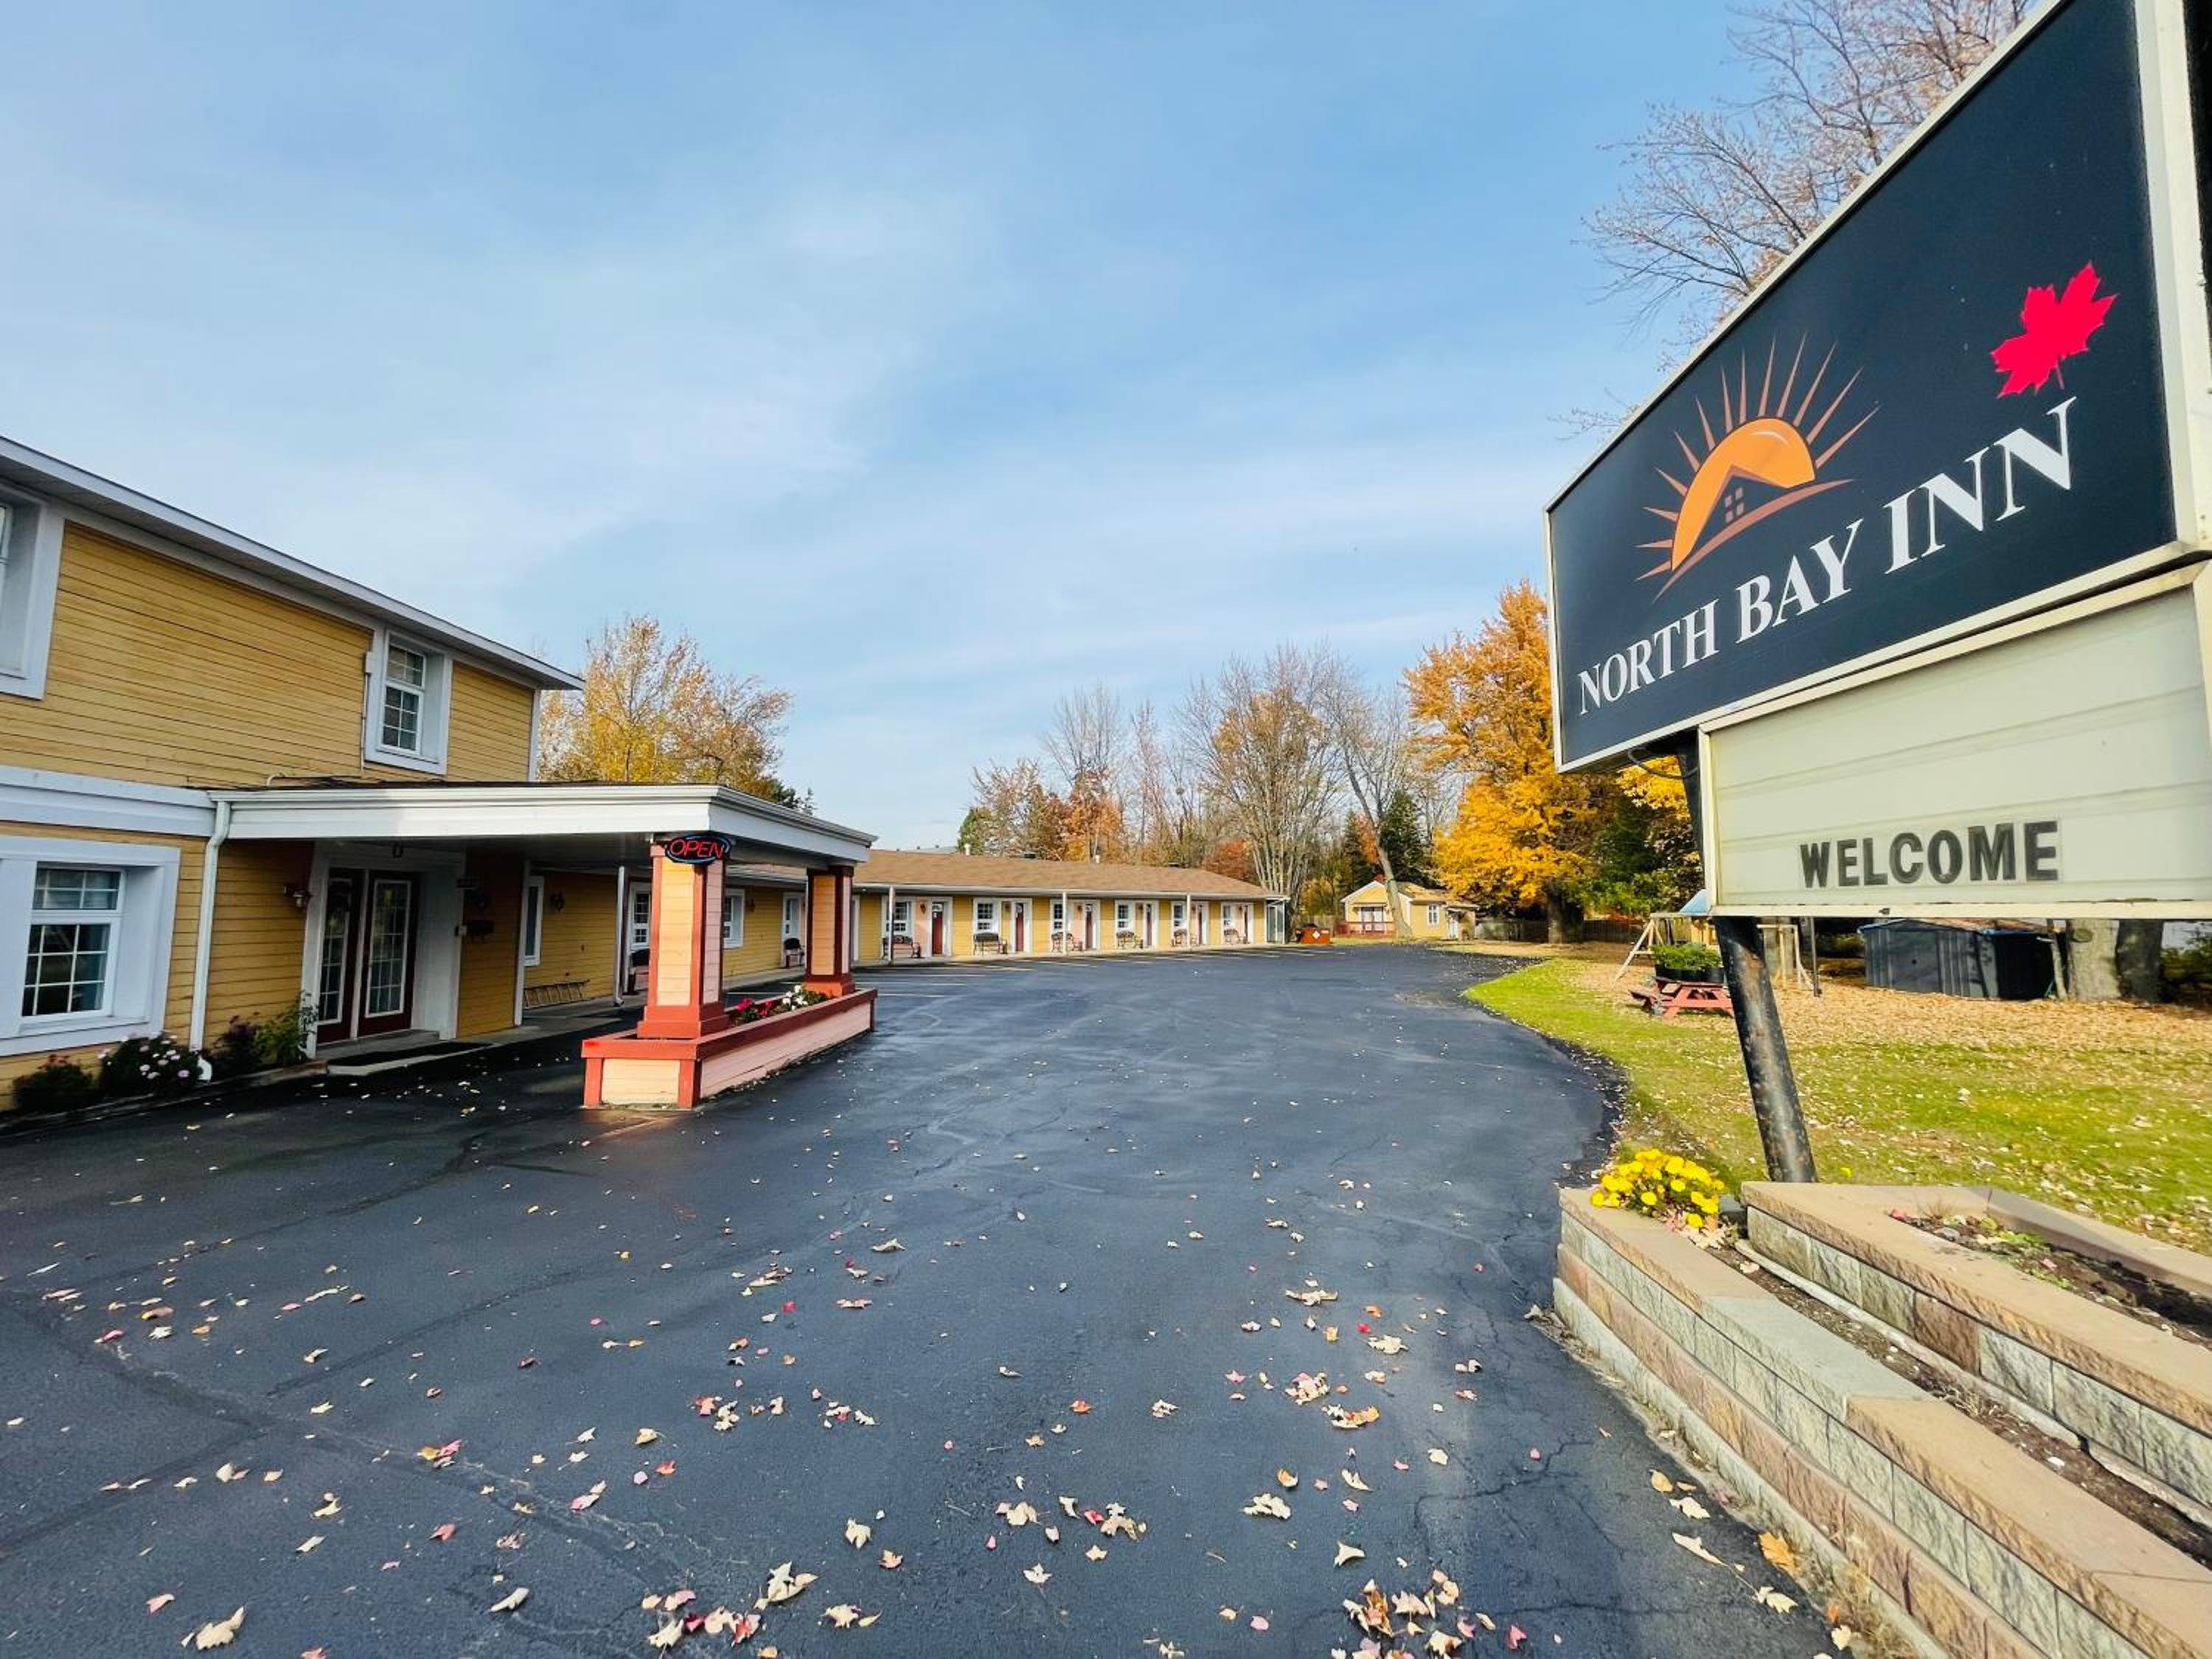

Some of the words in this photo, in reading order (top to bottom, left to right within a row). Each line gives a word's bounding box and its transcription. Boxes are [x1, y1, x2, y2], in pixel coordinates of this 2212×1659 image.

[1576, 598, 1719, 715] NORTH
[1735, 519, 1863, 644] BAY
[1882, 397, 2077, 574] INN
[670, 839, 724, 858] OPEN
[1799, 820, 2059, 889] WELCOME
